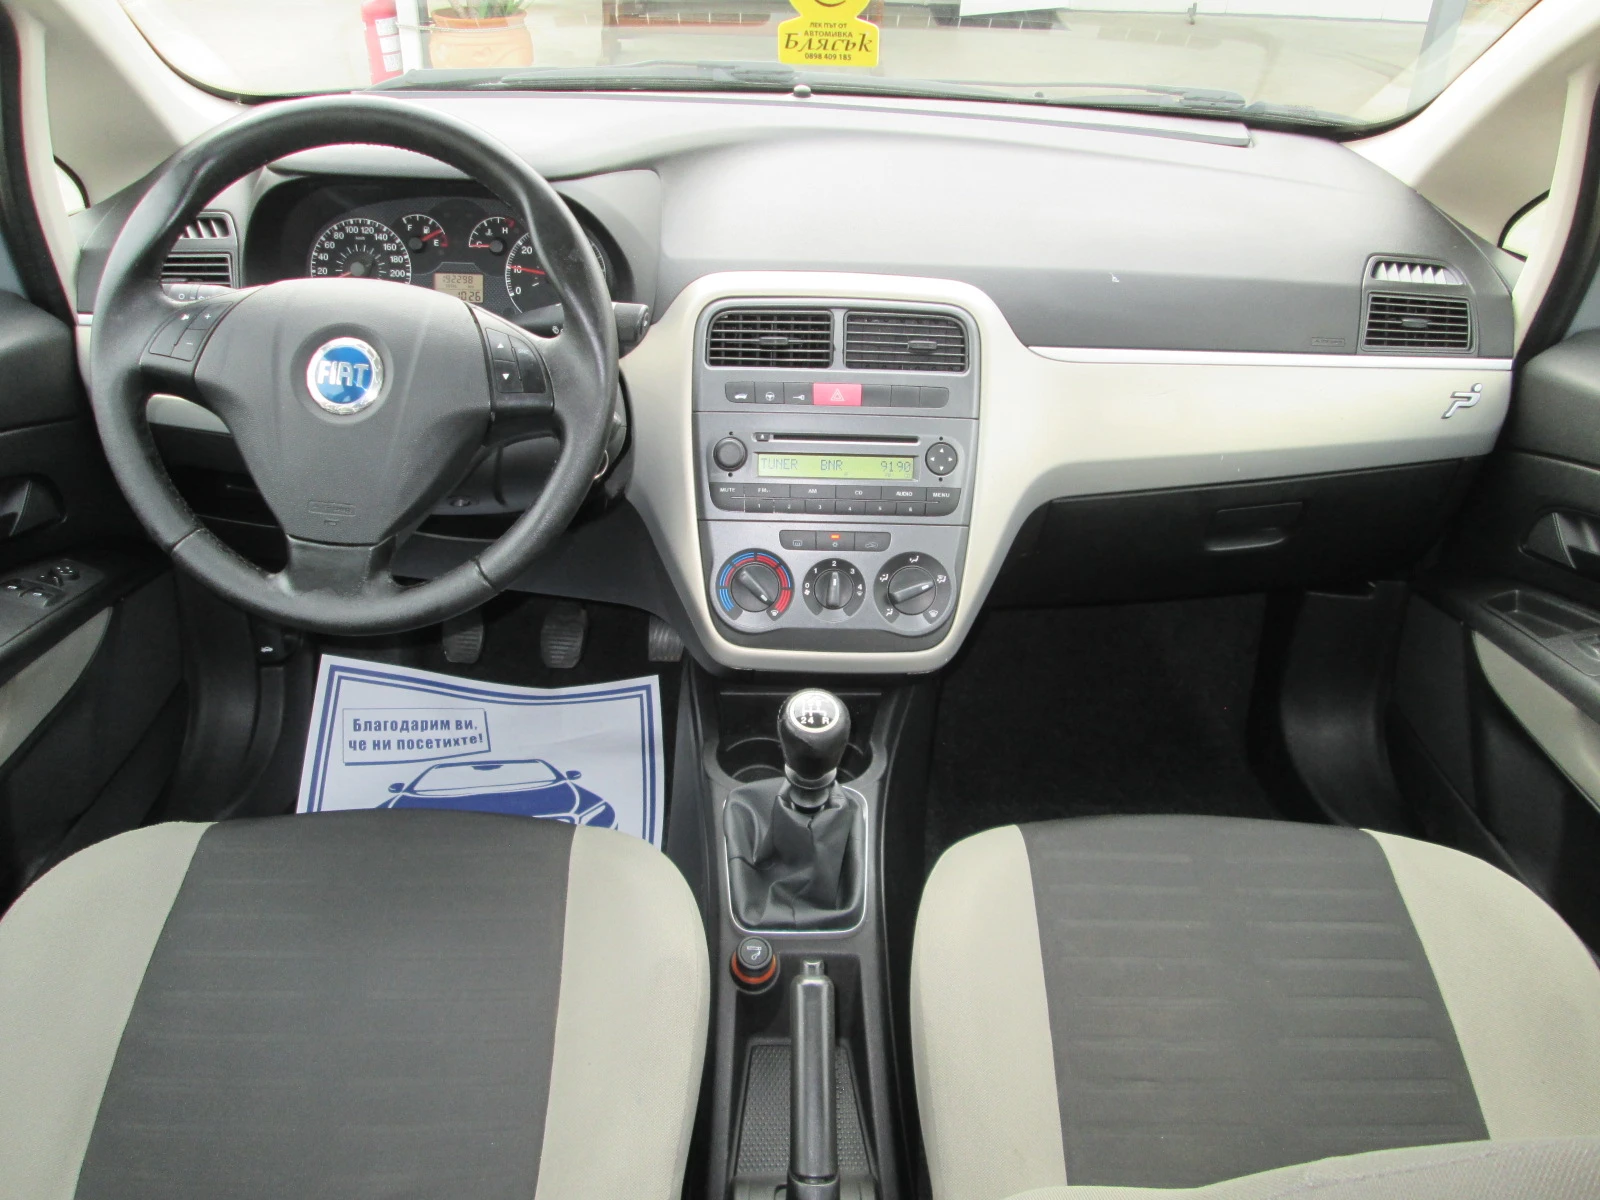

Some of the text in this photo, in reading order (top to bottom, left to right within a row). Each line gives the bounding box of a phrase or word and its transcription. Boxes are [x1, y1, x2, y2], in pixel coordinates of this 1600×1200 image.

[803, 30, 853, 38] АВТОМИВКА
[374, 233, 388, 241] 140
[324, 241, 335, 249] 60
[383, 243, 397, 251] 160
[433, 239, 439, 247] E
[521, 246, 533, 254] 20
[317, 267, 328, 275] 20
[390, 269, 405, 277] 200
[442, 275, 474, 285] 192298
[515, 286, 522, 295] 0
[317, 360, 369, 387] FIAT
[761, 458, 798, 470] TUNER
[820, 460, 843, 471] BNR
[800, 716, 830, 724] 2 4 R
[353, 718, 451, 733] Благодарим
[348, 733, 483, 751] че ни посетихте!
